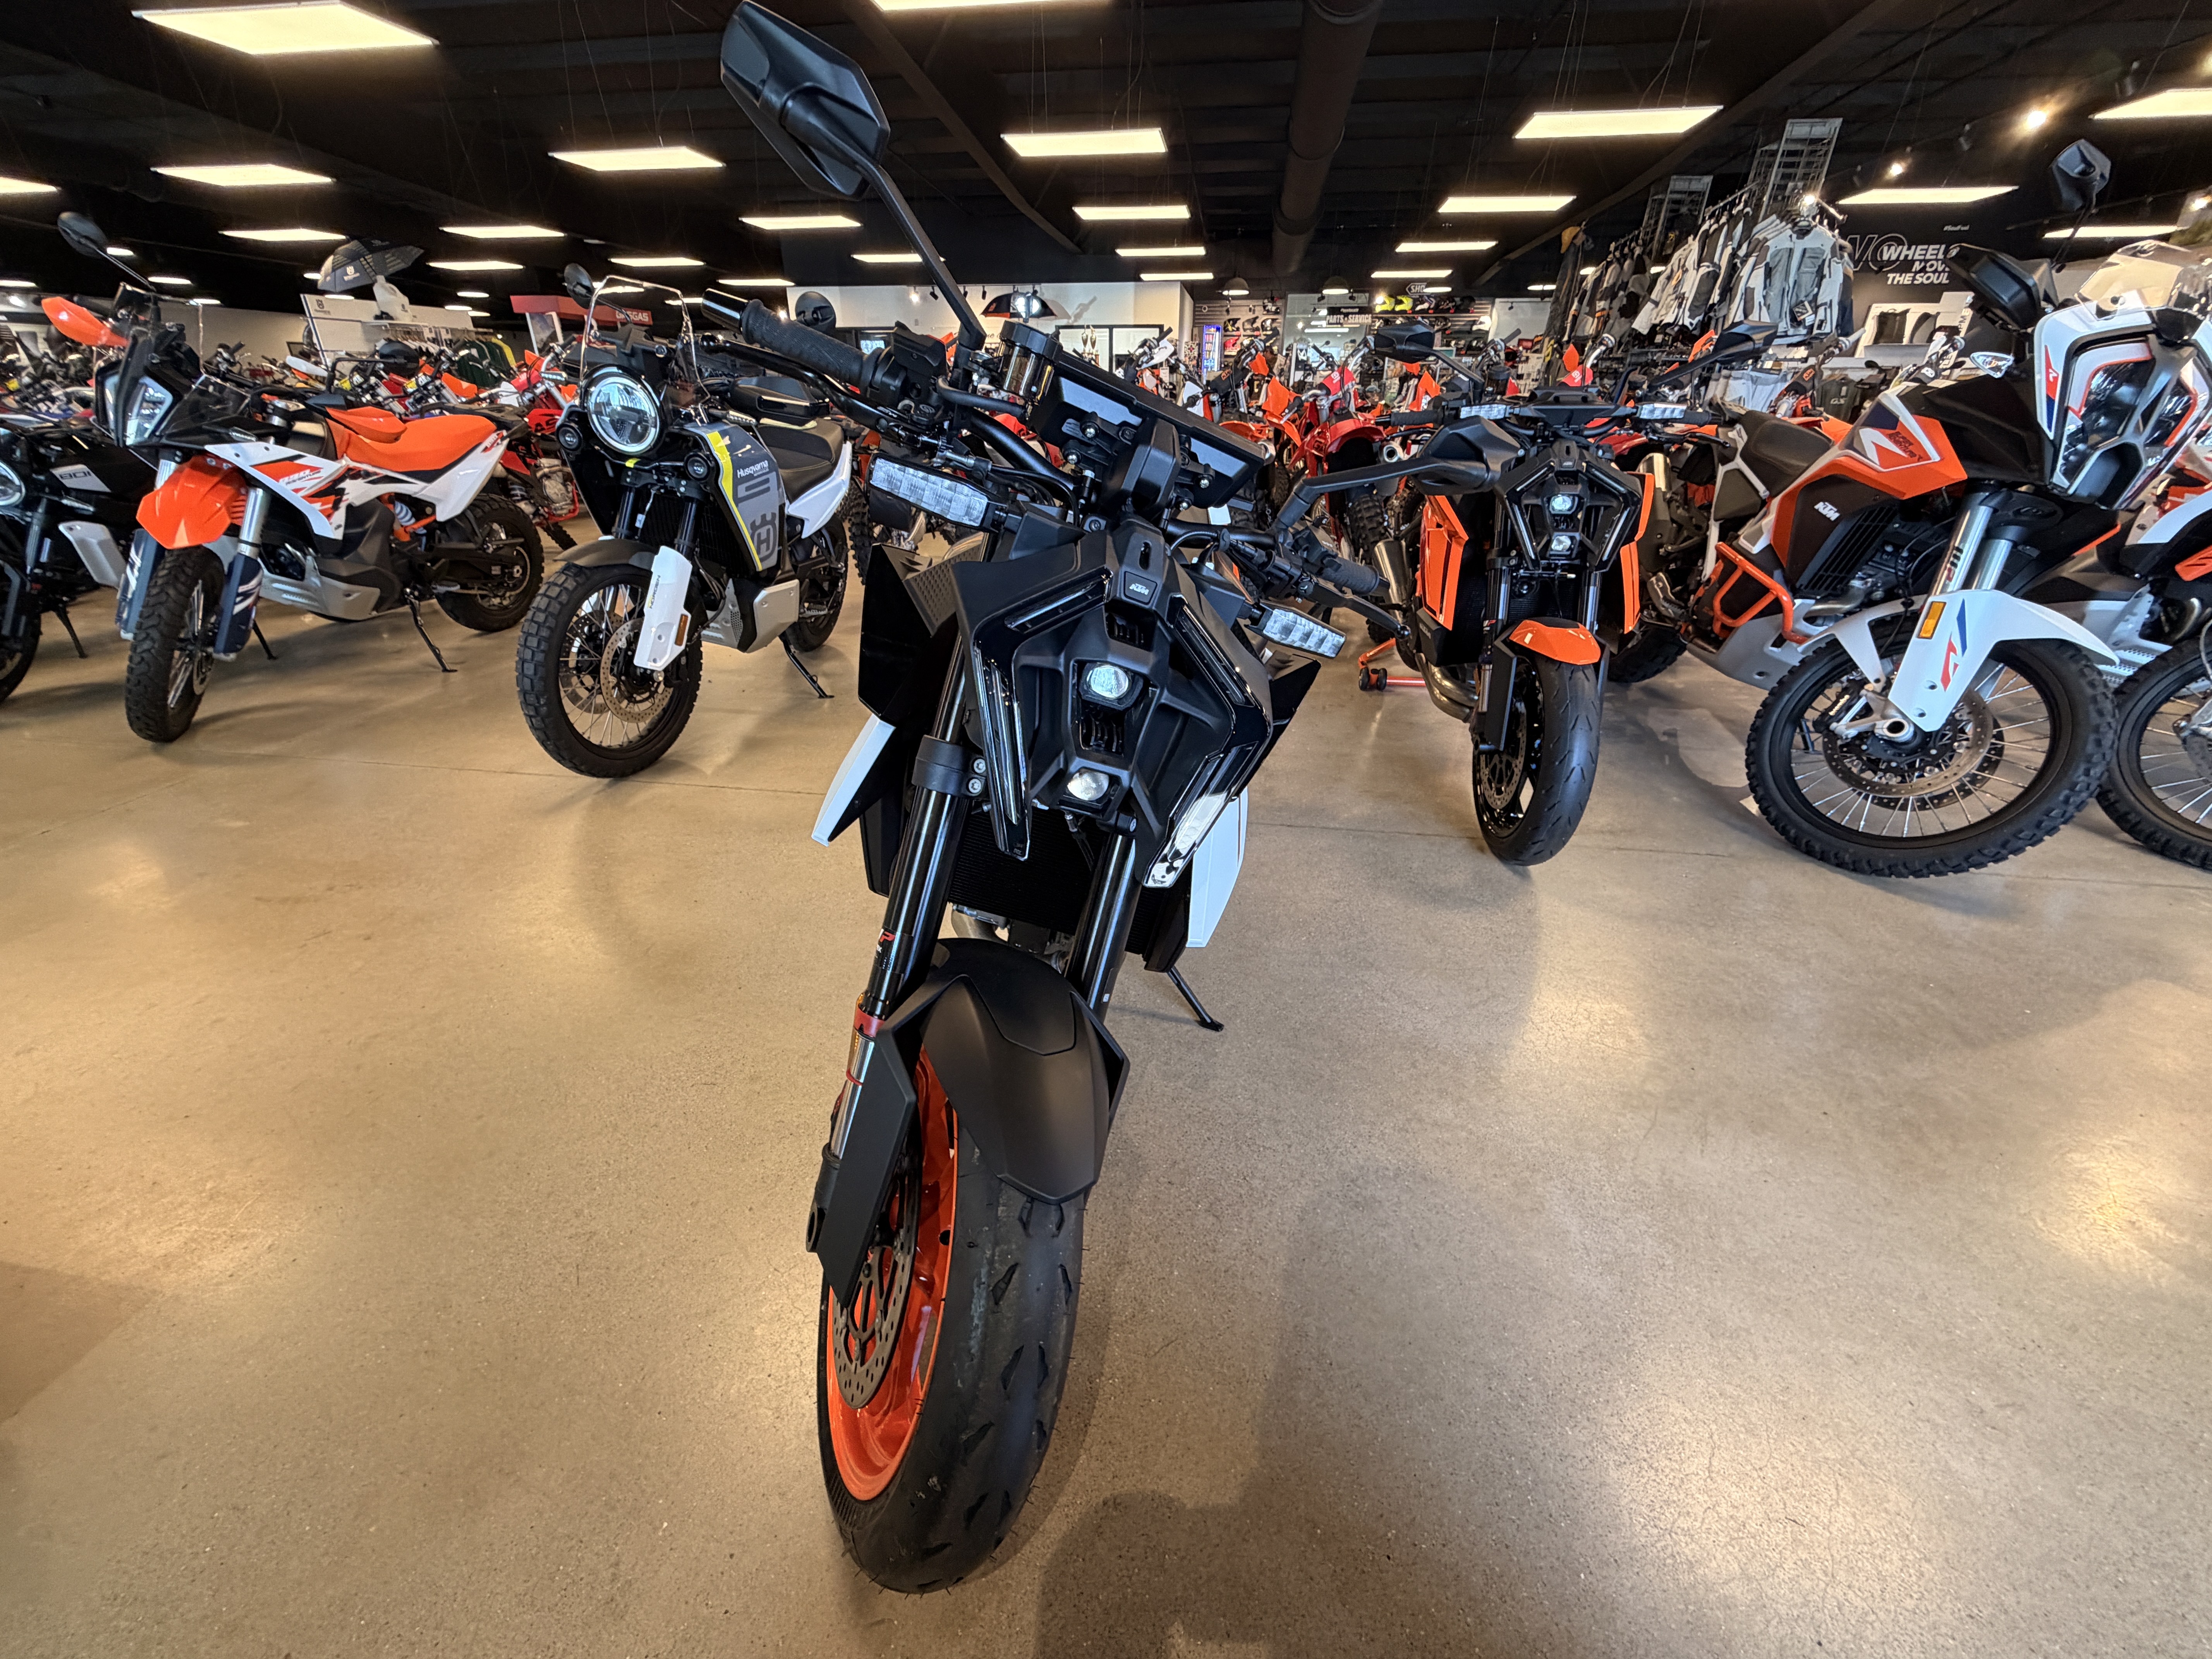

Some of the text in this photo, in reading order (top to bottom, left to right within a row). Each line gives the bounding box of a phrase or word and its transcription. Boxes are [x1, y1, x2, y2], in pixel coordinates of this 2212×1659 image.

[1882, 244, 1946, 260] WHEEL
[1911, 260, 1950, 272] MOV
[1887, 272, 1949, 285] THE SOUL
[1410, 284, 1426, 293] SHO
[616, 310, 649, 322] GSGAS
[1326, 314, 1372, 324] PARTS SERVICE
[737, 460, 769, 479] Husqvarna
[1814, 501, 1840, 521] KTM
[1129, 583, 1149, 595] KTM
[878, 928, 896, 943] P
